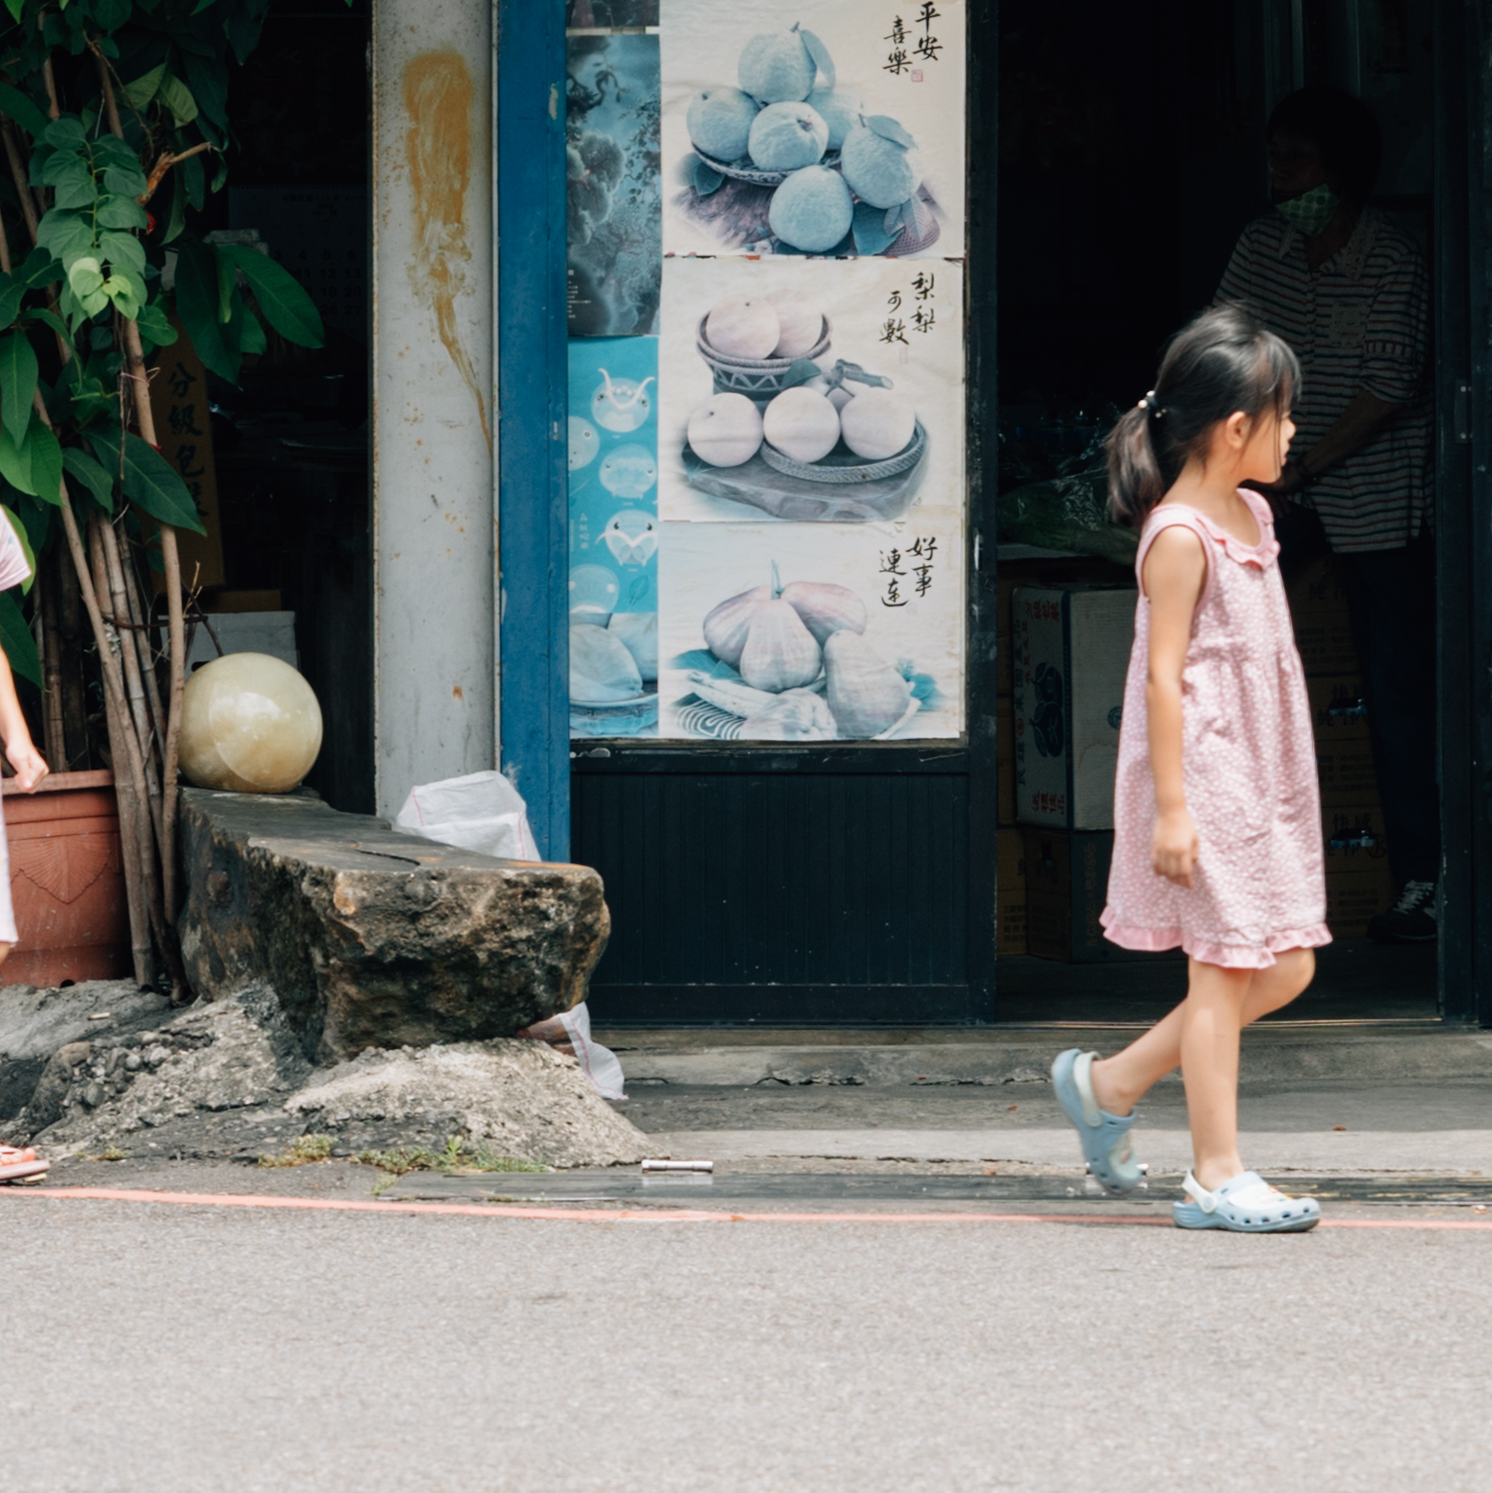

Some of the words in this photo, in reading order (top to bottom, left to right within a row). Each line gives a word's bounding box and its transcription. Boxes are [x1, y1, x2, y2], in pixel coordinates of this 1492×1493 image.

[883, 15, 912, 76] 喜樂
[912, 0, 944, 63] 平安
[878, 290, 910, 346] 可數
[910, 271, 936, 334] 梨梨
[906, 535, 938, 599] 好事
